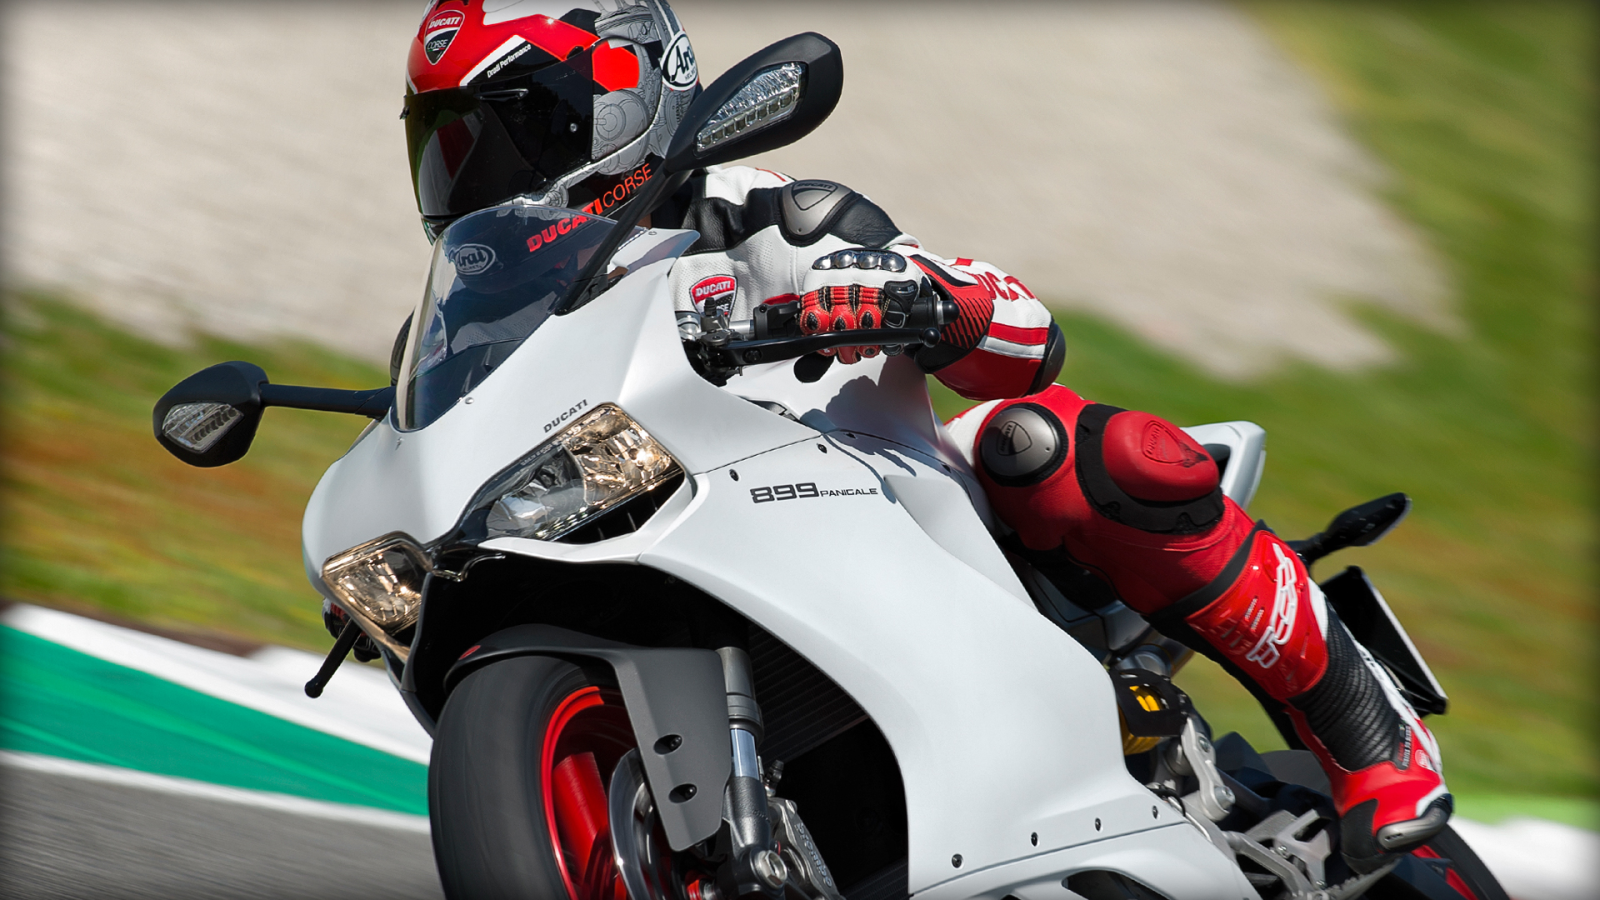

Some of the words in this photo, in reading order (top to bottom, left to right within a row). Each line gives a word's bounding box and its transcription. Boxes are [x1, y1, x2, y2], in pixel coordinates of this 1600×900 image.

[428, 16, 461, 29] DUCATI
[427, 39, 449, 50] CORSE
[500, 43, 532, 70] Performance
[796, 181, 833, 189] DUCATI
[526, 198, 604, 253] DUCATI
[602, 163, 653, 208] CORSE
[695, 280, 731, 297] DUCATI
[543, 399, 589, 434] DUCATI
[749, 482, 820, 504] 899
[819, 488, 879, 497] PANIGALE
[794, 822, 832, 887] brembo
